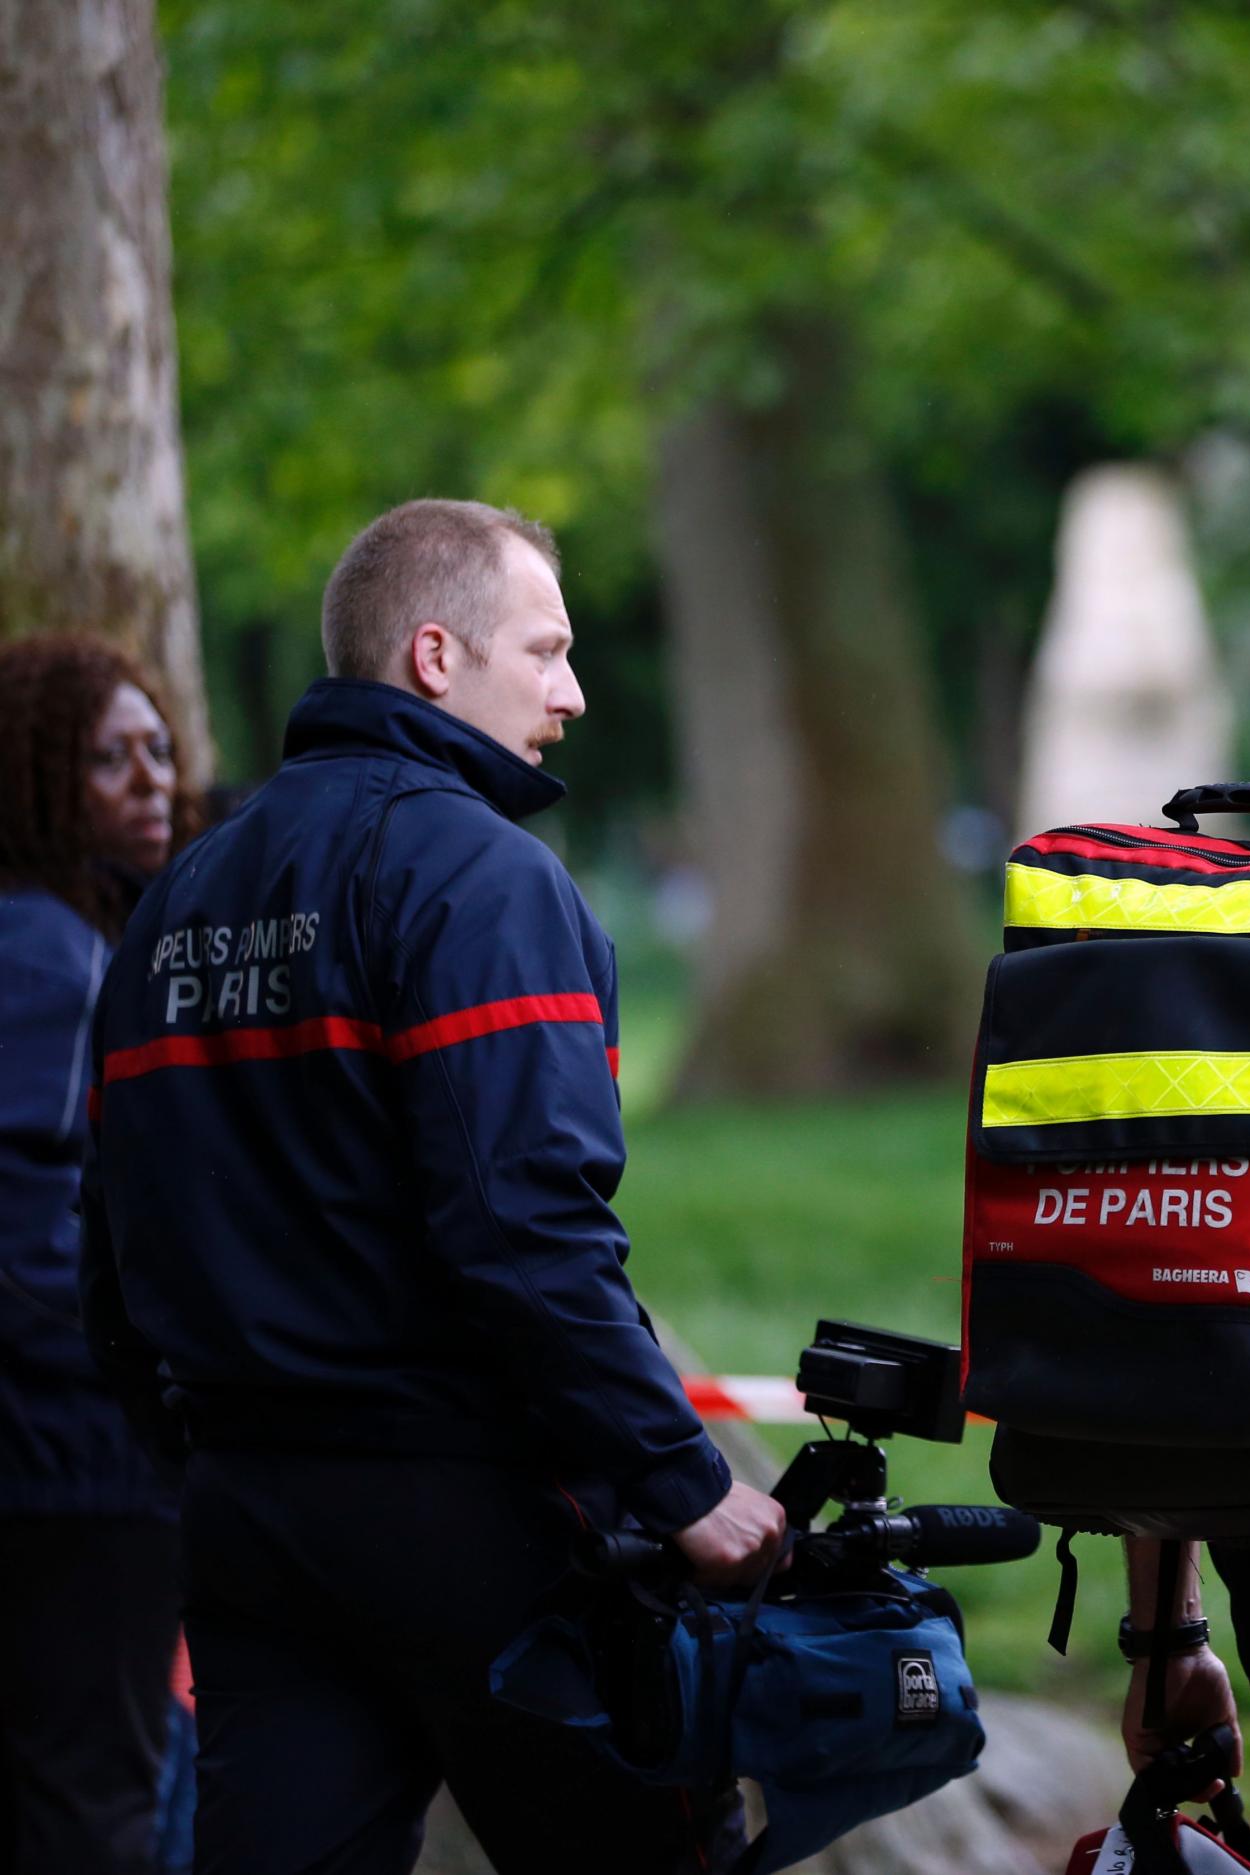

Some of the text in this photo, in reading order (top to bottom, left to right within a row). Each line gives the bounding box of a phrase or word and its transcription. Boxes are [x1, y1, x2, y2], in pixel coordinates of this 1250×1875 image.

[147, 926, 232, 982] PEURS
[1034, 1188, 1233, 1229] DE PARIS
[988, 1242, 1014, 1253] TYPH
[1152, 1267, 1230, 1284] BAGHEERA
